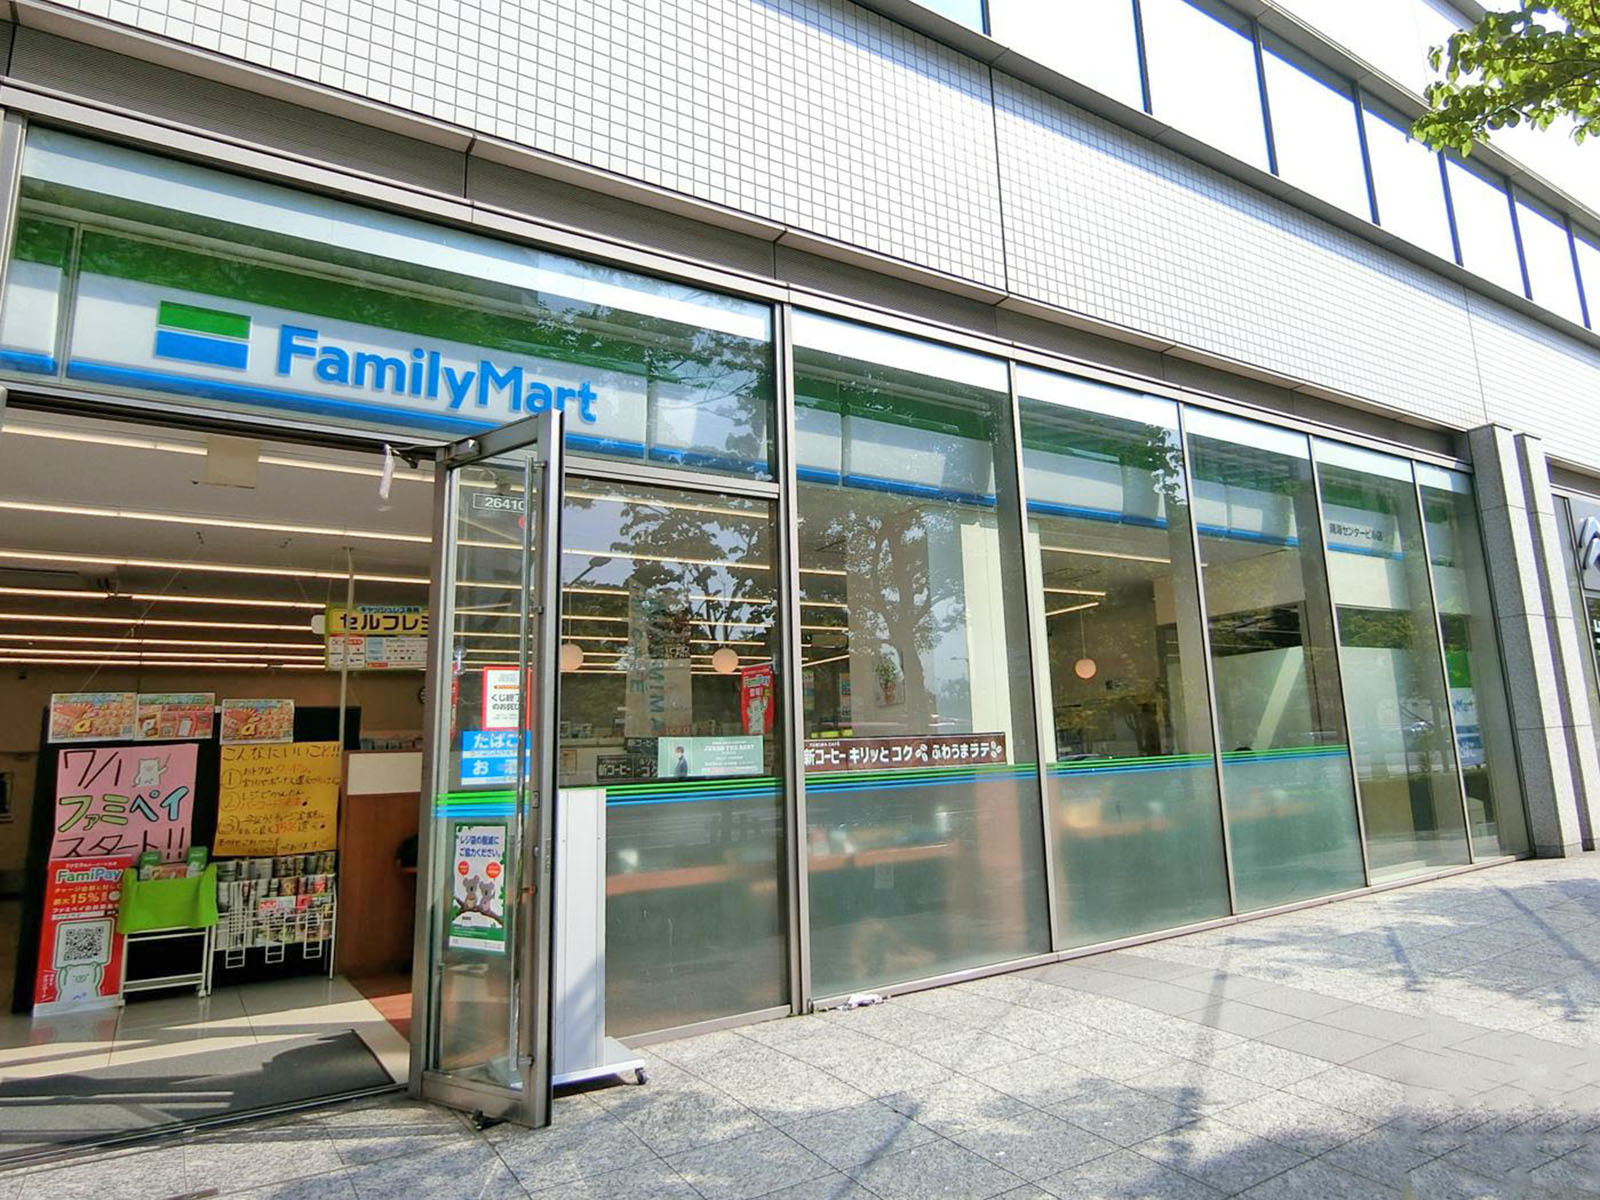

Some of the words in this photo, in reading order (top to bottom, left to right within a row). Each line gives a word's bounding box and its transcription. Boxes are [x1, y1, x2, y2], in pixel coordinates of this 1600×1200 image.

[275, 323, 599, 424] FamilyMart
[484, 496, 525, 511] 26410
[64, 750, 122, 789] 7/1
[803, 749, 847, 766] 新コーヒー
[932, 742, 991, 760] ふわうまラテ
[58, 786, 189, 832] ファミペイ
[55, 867, 123, 884] FamiPay
